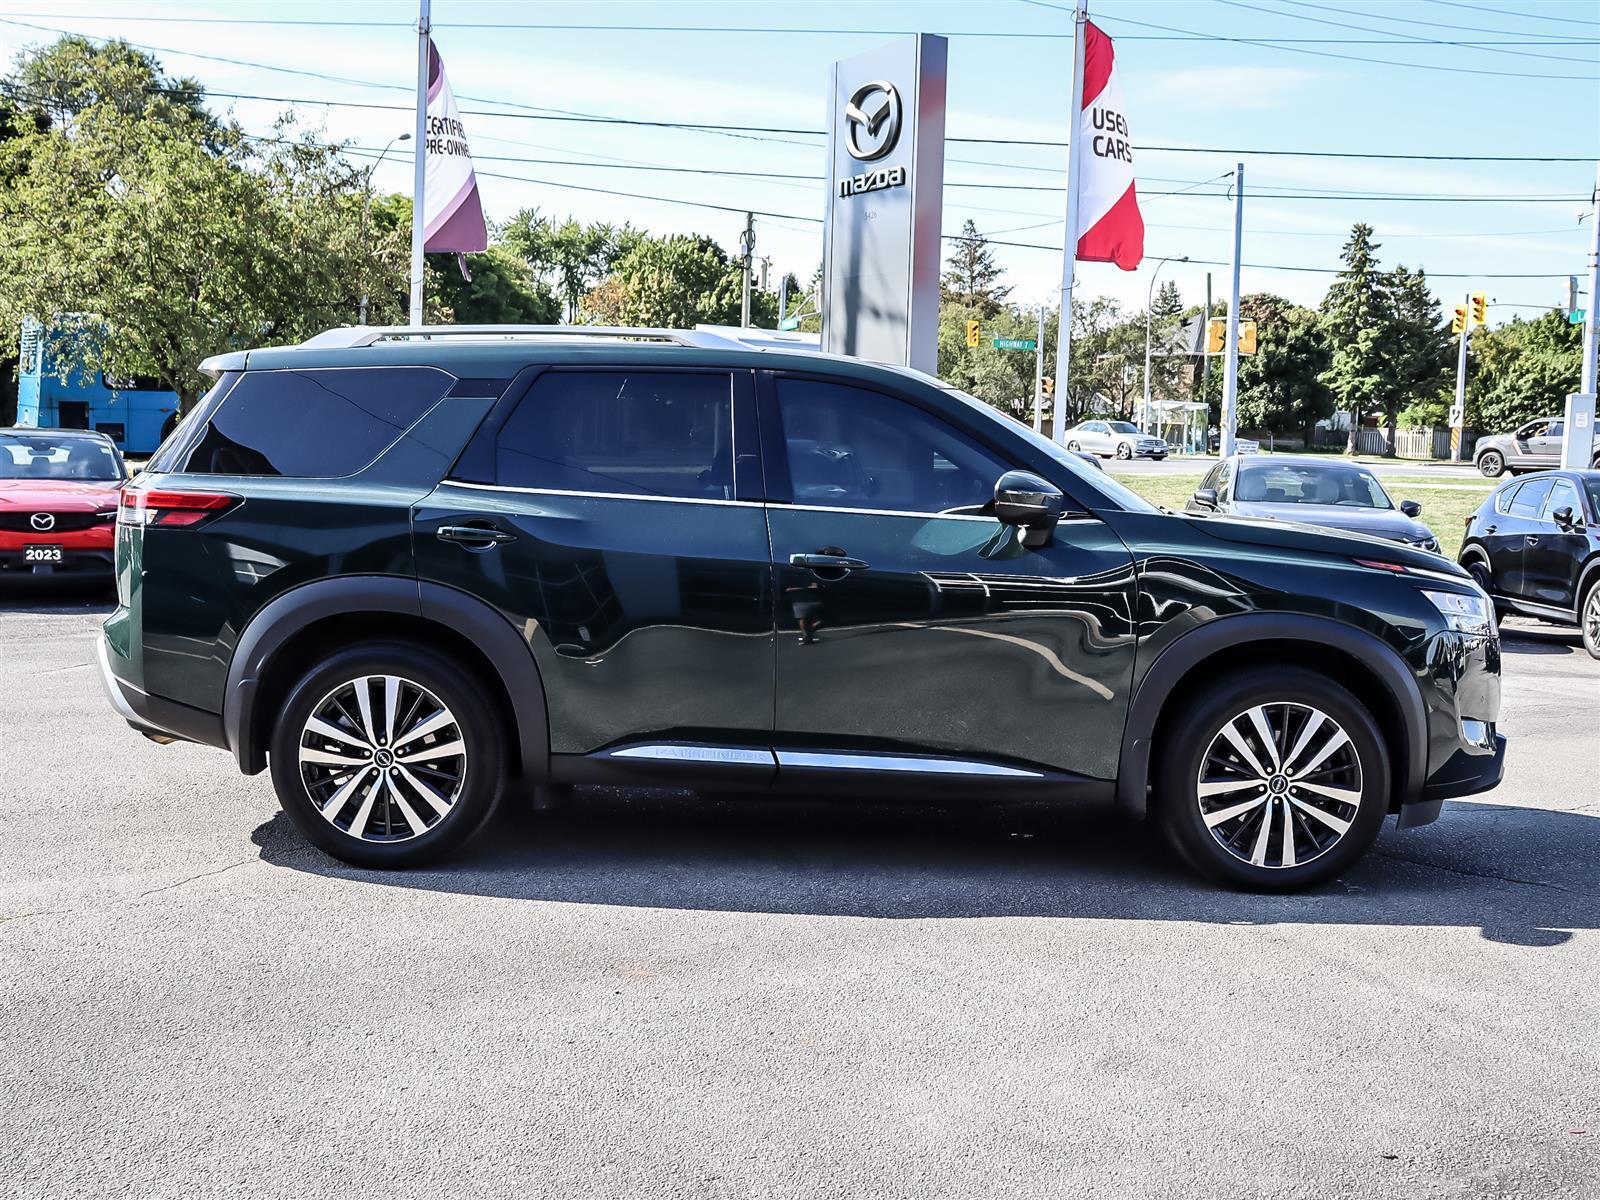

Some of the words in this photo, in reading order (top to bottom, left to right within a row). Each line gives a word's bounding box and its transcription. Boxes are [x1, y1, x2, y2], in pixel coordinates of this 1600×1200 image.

[427, 115, 467, 140] ERTIFIE
[1092, 107, 1128, 137] USED
[426, 138, 471, 159] RE-OWNE
[1092, 135, 1132, 163] CARS
[839, 165, 906, 198] mazda
[1000, 340, 1023, 349] HIGHWAY
[25, 549, 62, 561] 2023
[655, 747, 768, 762] PATHFINDER
